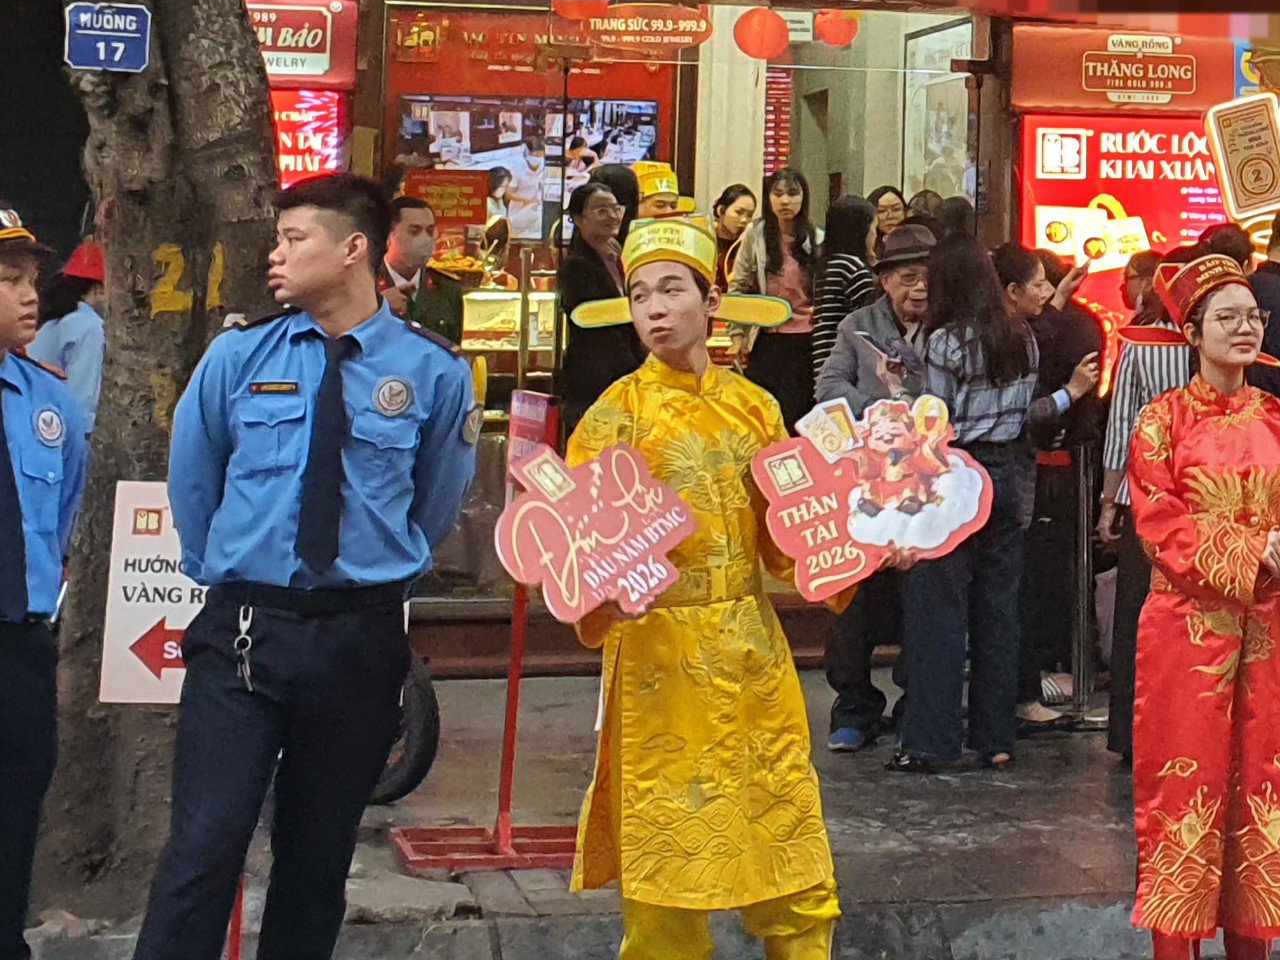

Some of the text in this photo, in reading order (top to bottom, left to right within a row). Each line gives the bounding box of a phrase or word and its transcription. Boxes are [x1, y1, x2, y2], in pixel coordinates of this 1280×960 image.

[277, 22, 323, 48] BẢO
[590, 18, 625, 31] TRANG
[627, 16, 649, 31] SỨC
[96, 41, 125, 61] 17
[1111, 38, 1139, 48] VÀNG
[1085, 58, 1192, 79] THĂNG LONG
[1100, 129, 1167, 155] RƯỚC
[1100, 159, 1155, 179] KHAI
[777, 492, 839, 528] THẦN
[801, 520, 839, 547] TÀI
[806, 540, 858, 575] 2026
[617, 554, 668, 602] 2026
[122, 583, 182, 604] VÀNG
